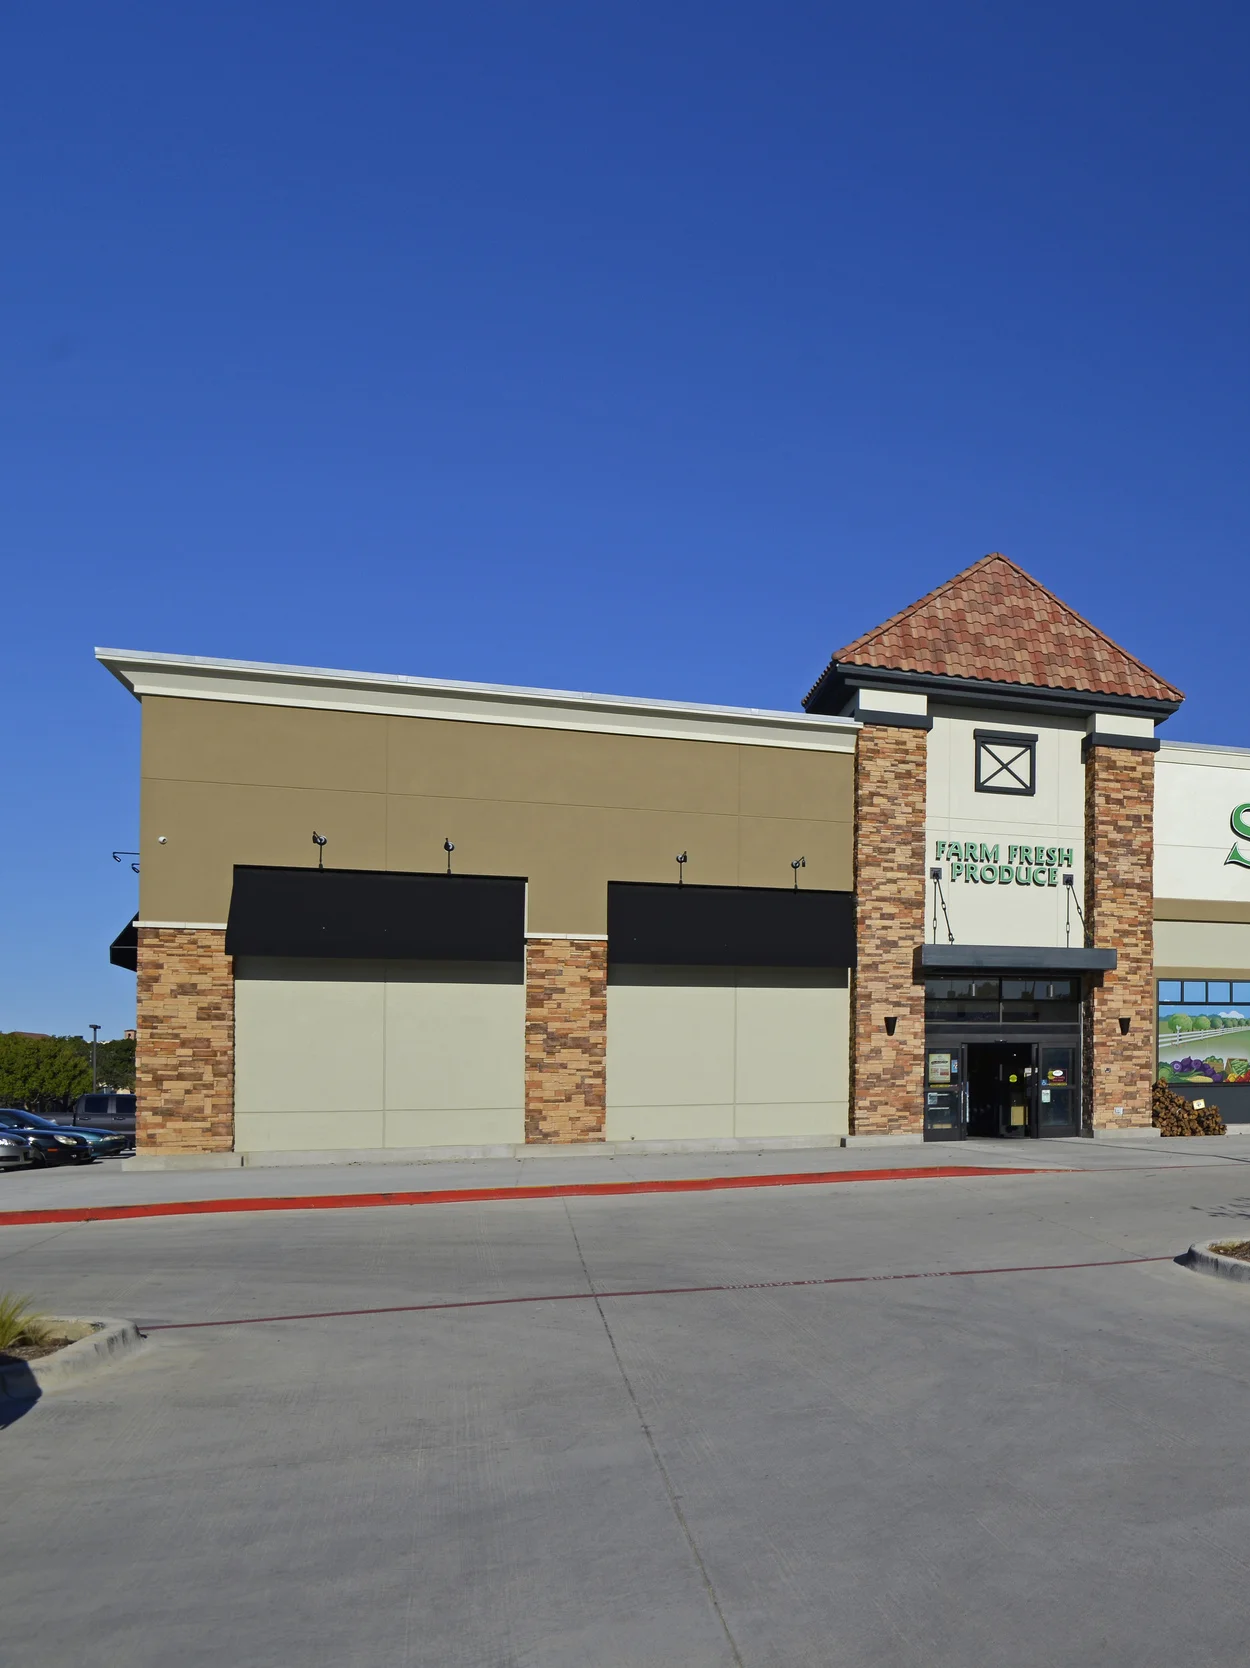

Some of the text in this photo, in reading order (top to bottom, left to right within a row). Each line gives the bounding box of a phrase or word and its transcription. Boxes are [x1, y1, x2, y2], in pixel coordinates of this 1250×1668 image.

[935, 840, 1074, 867] FARM FRESH
[950, 862, 1059, 887] PRODUCE
